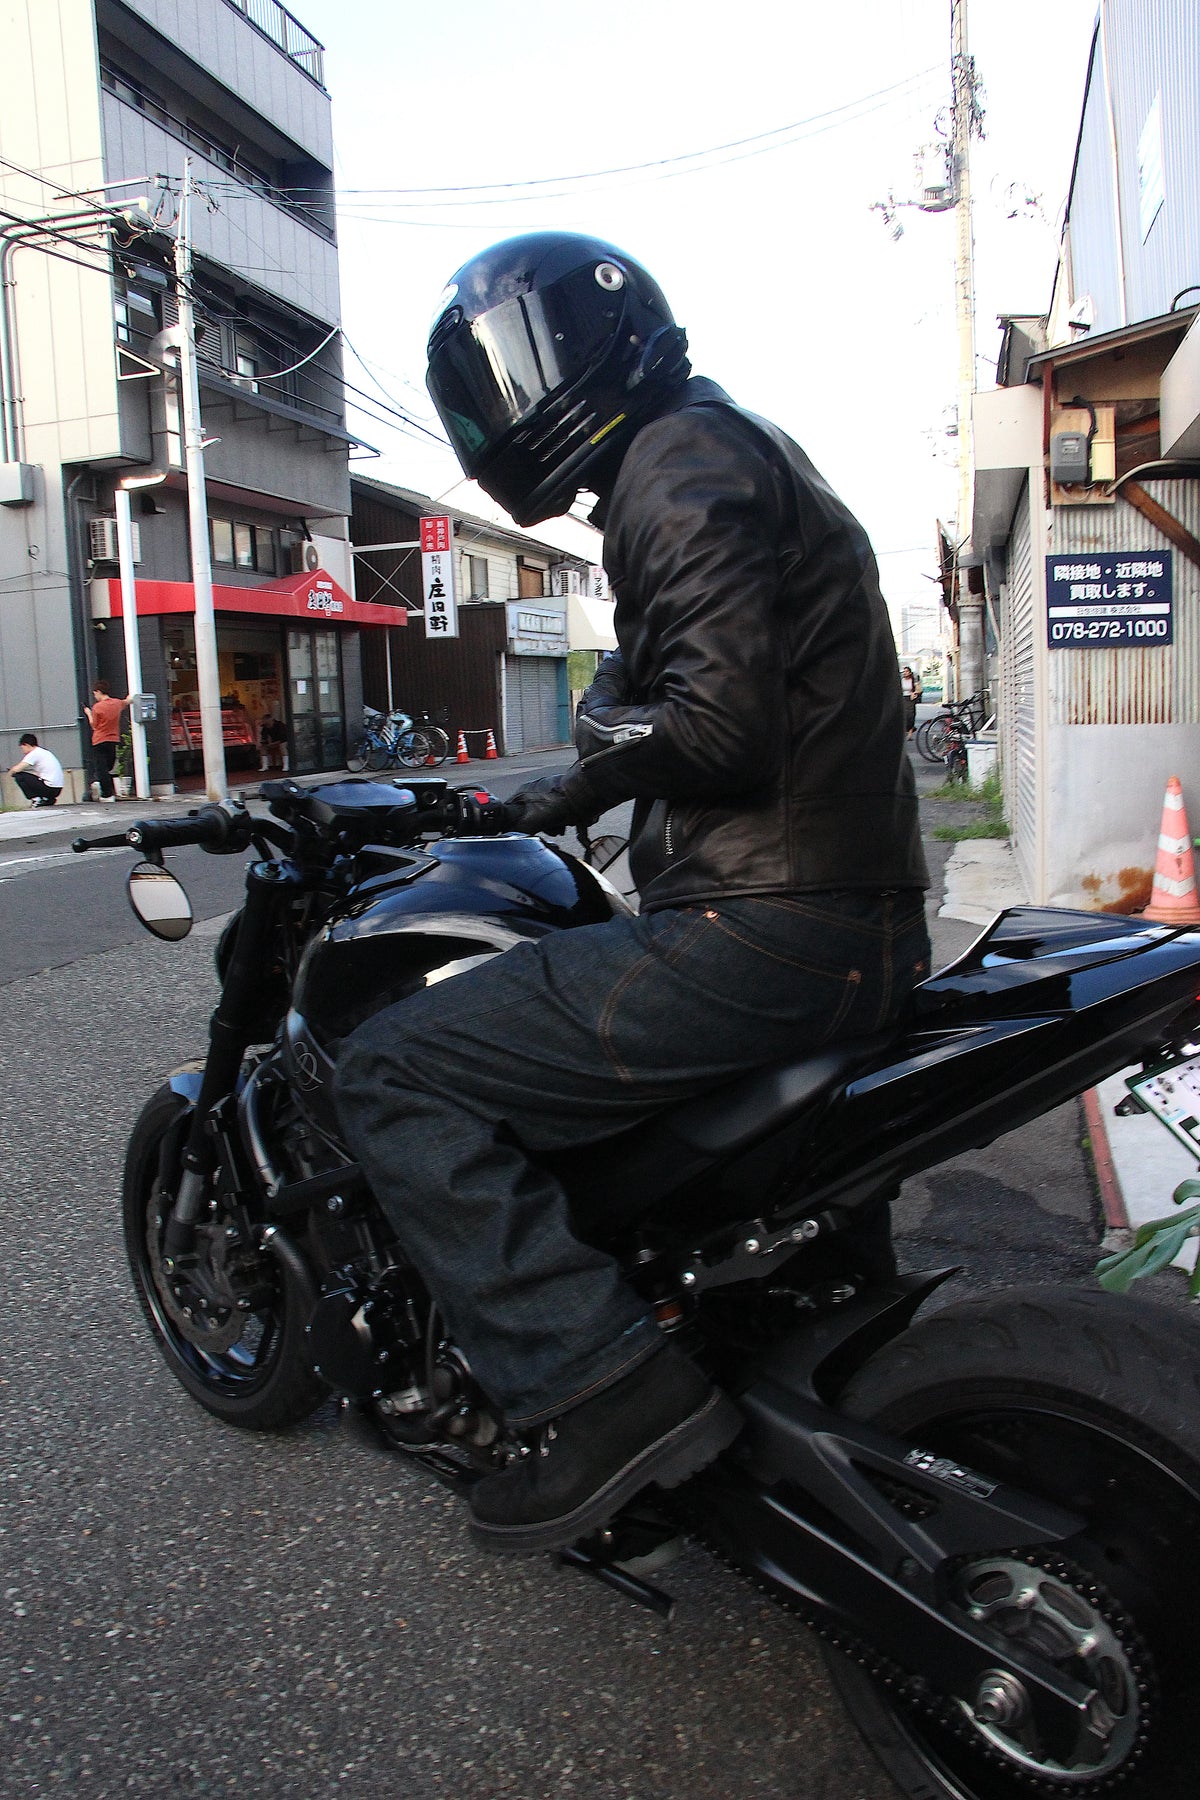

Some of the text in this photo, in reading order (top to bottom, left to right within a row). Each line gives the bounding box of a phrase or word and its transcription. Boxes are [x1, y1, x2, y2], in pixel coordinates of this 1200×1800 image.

[1069, 582, 1156, 600] 買取します。
[1052, 620, 1168, 640] 078-272-1000
